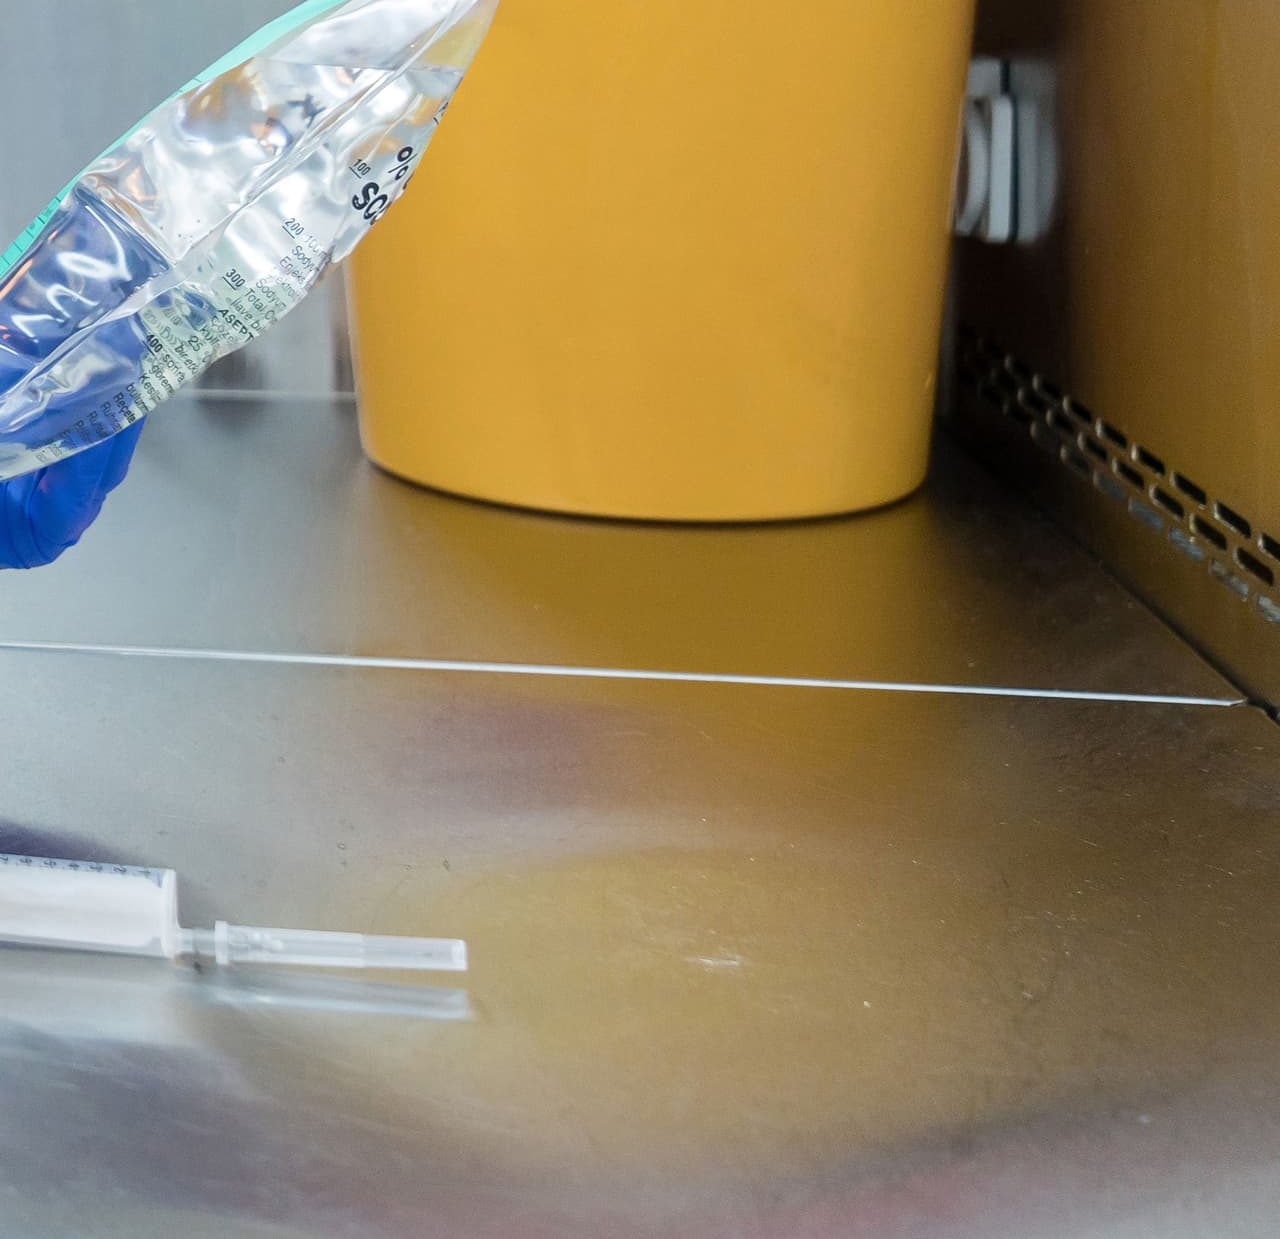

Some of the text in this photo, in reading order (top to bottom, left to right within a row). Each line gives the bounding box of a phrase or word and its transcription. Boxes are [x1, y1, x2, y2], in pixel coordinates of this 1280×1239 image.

[352, 159, 371, 176] 100
[285, 217, 305, 236] 200
[226, 268, 246, 288] 300
[245, 288, 266, 313] Total
[219, 309, 255, 343] ASEPT
[146, 334, 163, 353] 400
[188, 335, 201, 352] 25
